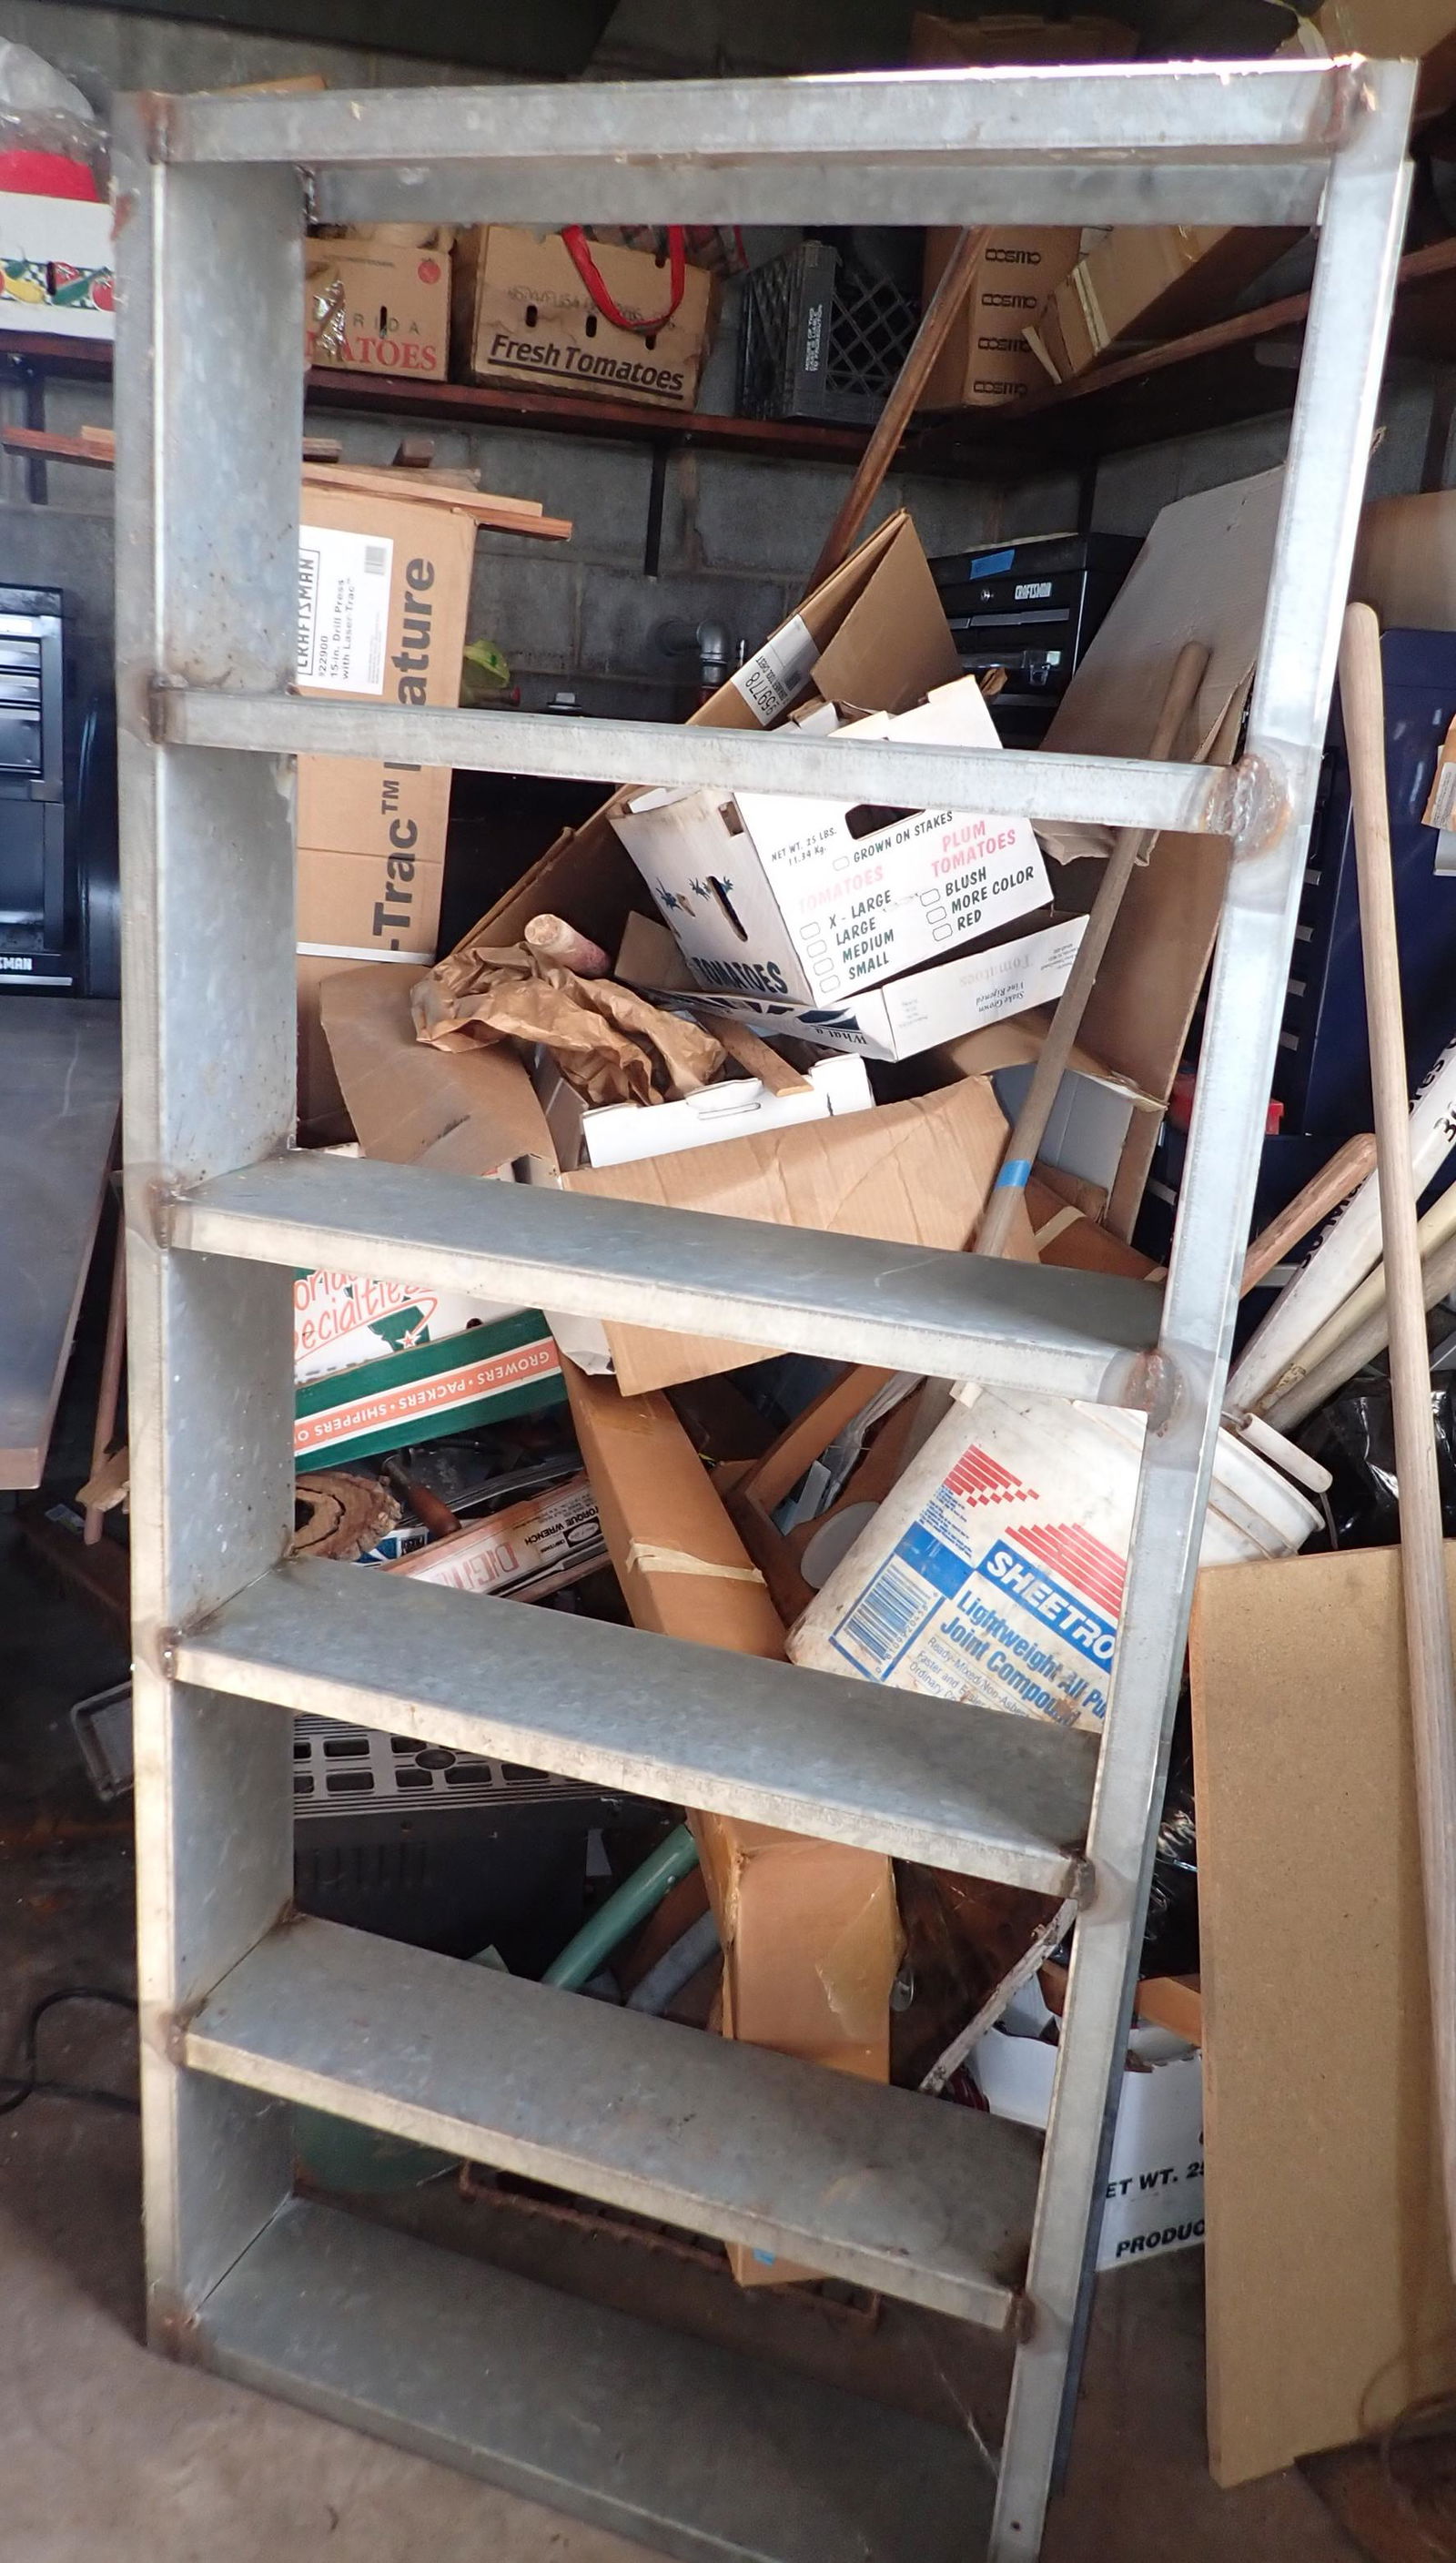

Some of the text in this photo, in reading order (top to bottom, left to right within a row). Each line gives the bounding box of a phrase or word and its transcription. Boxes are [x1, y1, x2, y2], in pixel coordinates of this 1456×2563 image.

[985, 248, 1041, 265] COSMO
[981, 293, 1037, 309] COSMO
[978, 337, 1033, 353] COSMO
[490, 334, 684, 391] Fresh Tomatoes
[973, 380, 1028, 396] COSMO
[335, 579, 345, 613] Press
[333, 616, 343, 642] Drill
[342, 653, 351, 679] with
[745, 672, 777, 715] 959778
[771, 848, 786, 863] NET
[789, 842, 804, 855] WT.
[819, 827, 837, 841] LBS.
[854, 811, 953, 864] GROWN ON STAKES
[942, 820, 986, 852] PLUM
[789, 844, 827, 866] 11.34 Kg.
[931, 829, 1016, 877] TOMATOES
[799, 866, 885, 913] TOMATOES
[945, 866, 986, 897] BLUSH
[951, 866, 1034, 914] MORE COLOR
[829, 914, 837, 929] X
[851, 889, 892, 919] LARGE
[957, 909, 982, 931] RED
[836, 917, 876, 946] LARGE
[842, 928, 895, 963] MEDIUM
[693, 957, 788, 994] TOMATOES
[848, 951, 890, 980] SMALL
[959, 955, 1034, 988] Tomatoes
[976, 981, 1024, 1006] Vine Ripened
[978, 990, 1024, 1012] Stake Grown
[829, 1029, 867, 1045] What
[477, 1352, 550, 1385] GROWERS
[398, 1381, 466, 1411] PACKERS
[314, 1403, 388, 1436] SHIPPERS
[524, 1523, 564, 1546] WRENCH
[986, 1551, 1116, 1659] SHEETRO
[956, 1590, 1064, 1682] Lightweight
[1057, 1671, 1089, 1699] All
[909, 1661, 943, 1695] Ordinary
[917, 1650, 942, 1675] Faster
[942, 1674, 959, 1688] and
[940, 1616, 1081, 1727] Joint Compoud
[1139, 2168, 1178, 2190] WT.
[1116, 2219, 1205, 2258] PRODUC
